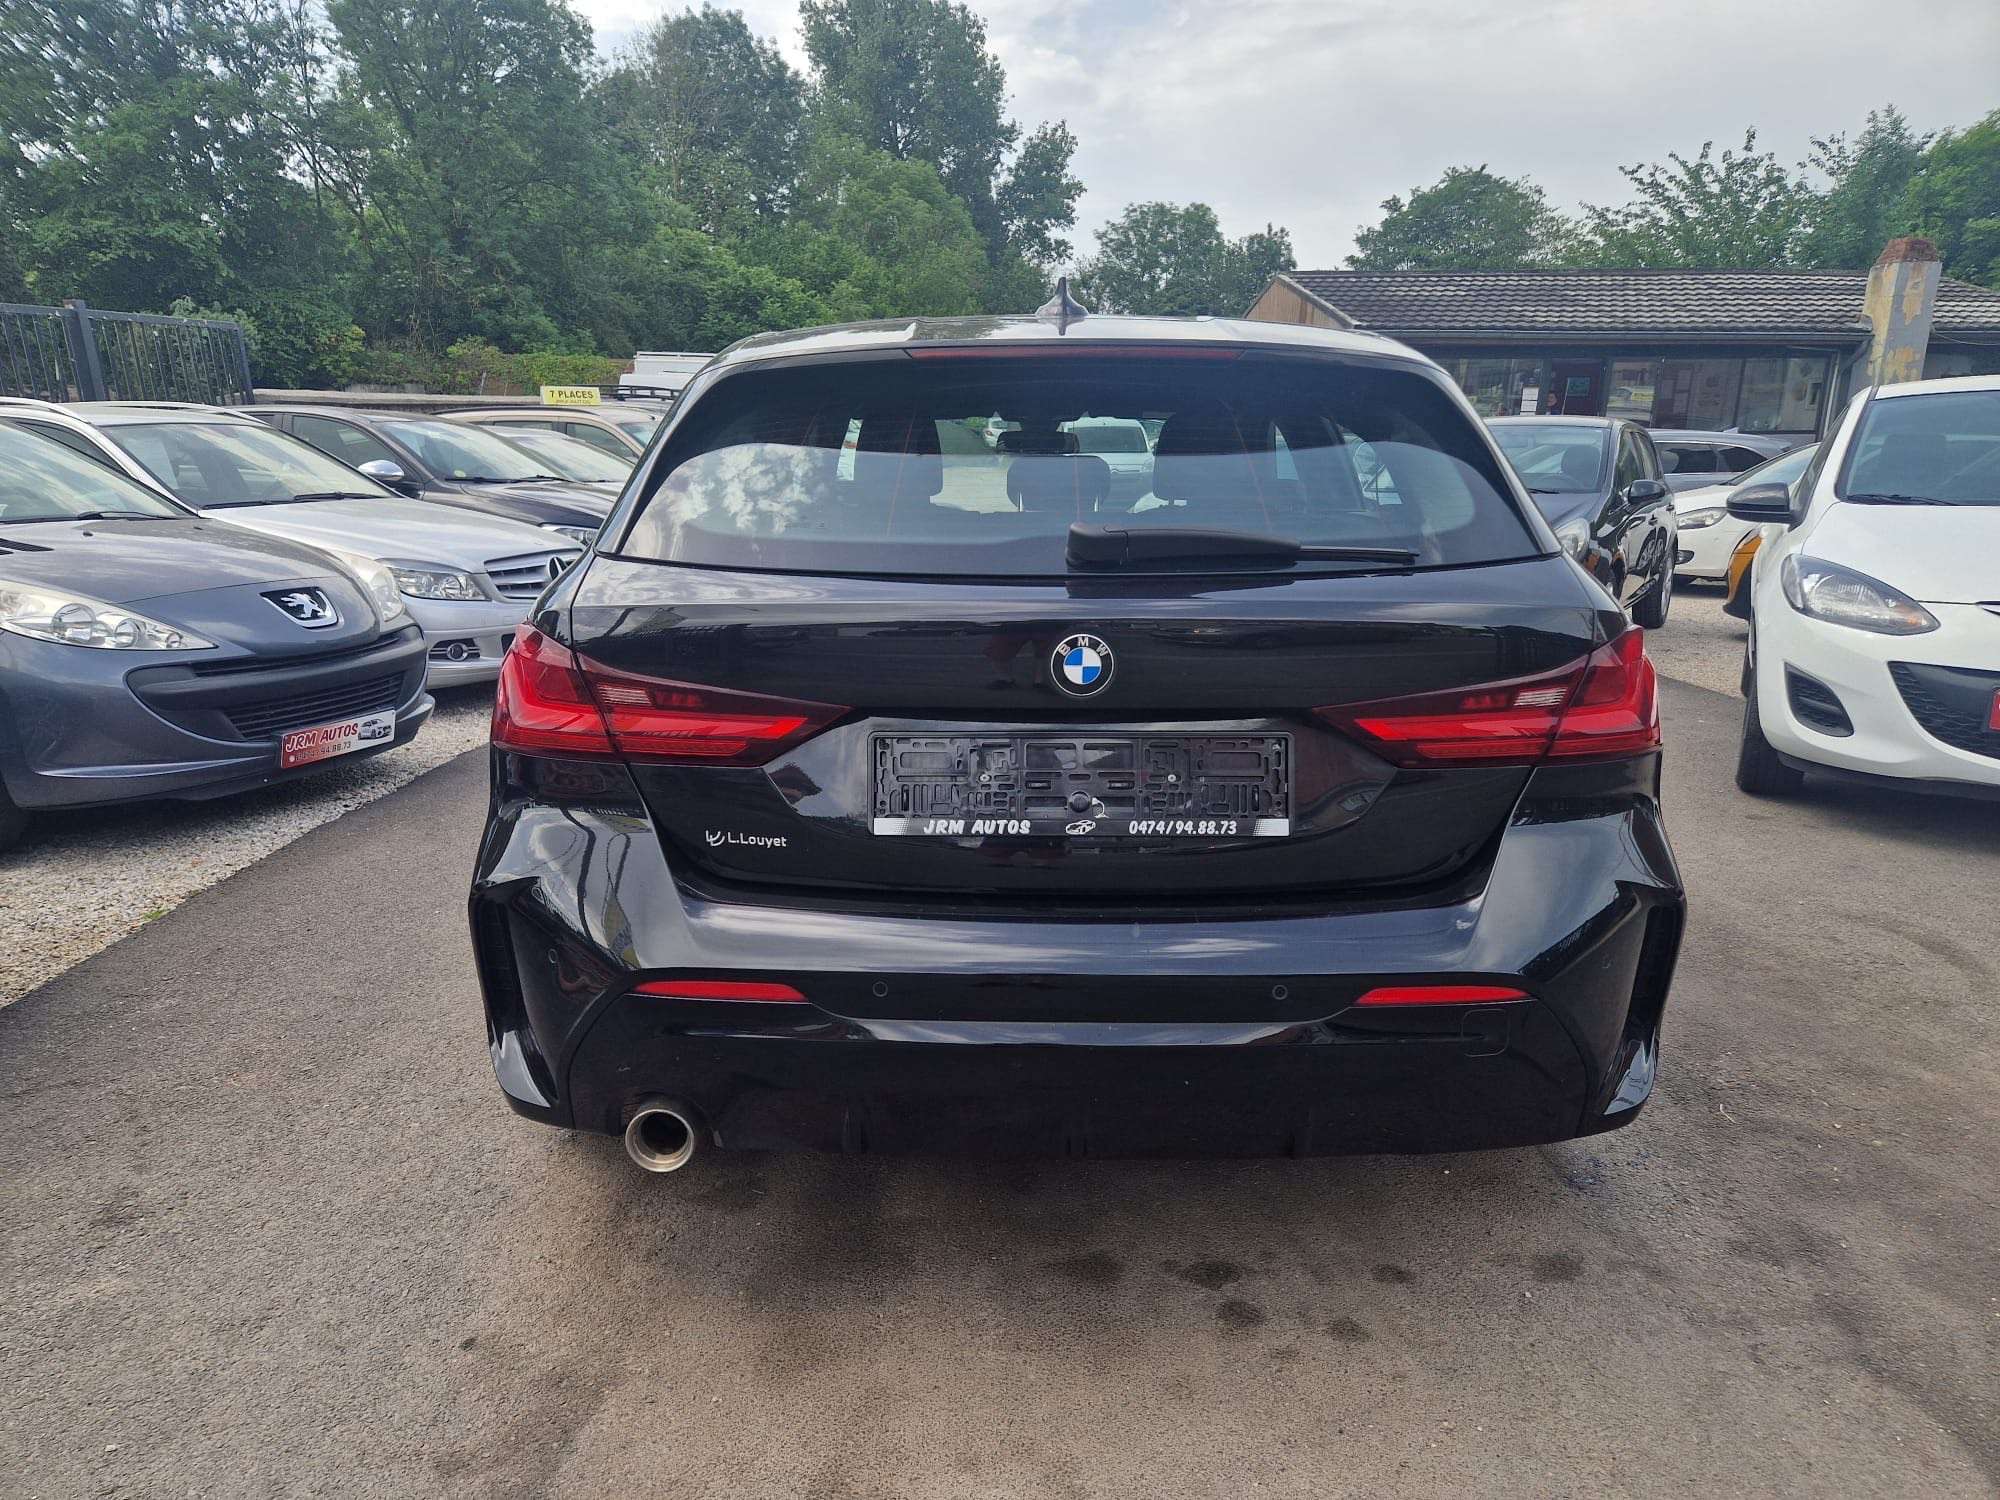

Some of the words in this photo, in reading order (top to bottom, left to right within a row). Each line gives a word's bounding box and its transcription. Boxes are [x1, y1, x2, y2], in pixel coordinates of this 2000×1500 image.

[549, 390, 555, 398] 7
[558, 390, 594, 399] PLACES
[1058, 636, 1109, 656] BMW
[285, 730, 318, 753] JRM
[320, 722, 359, 745] AUTOS
[923, 819, 965, 835] JRM
[971, 819, 1031, 835] AUTOS
[1128, 820, 1238, 835] 0474/94.88.73
[728, 831, 787, 849] L.Louyet
